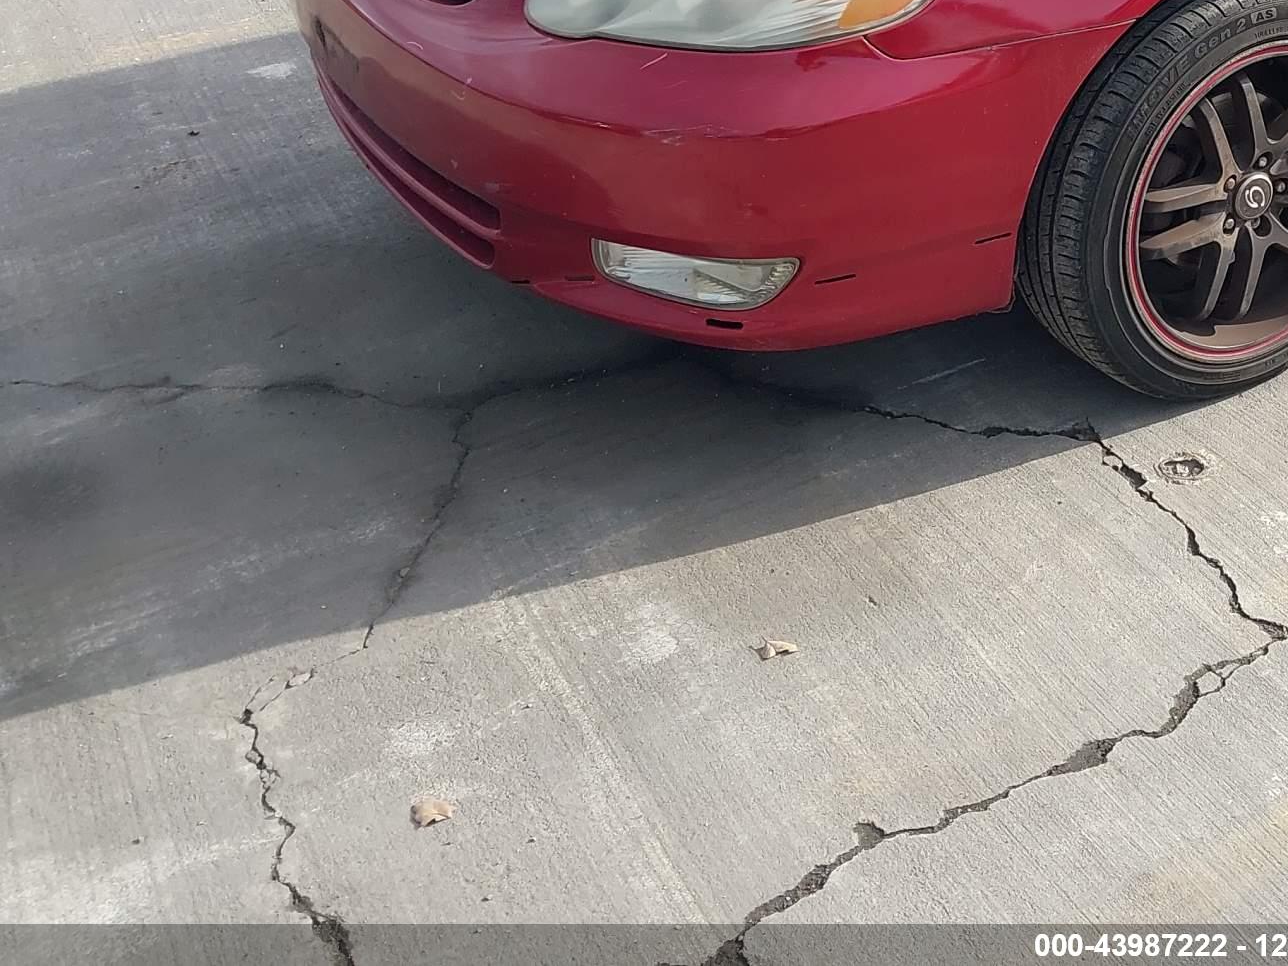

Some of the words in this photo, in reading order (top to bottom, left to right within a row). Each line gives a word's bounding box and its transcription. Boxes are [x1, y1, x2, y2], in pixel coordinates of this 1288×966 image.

[1194, 29, 1232, 59] Gen
[1236, 18, 1247, 34] 2
[1255, 8, 1275, 22] AS
